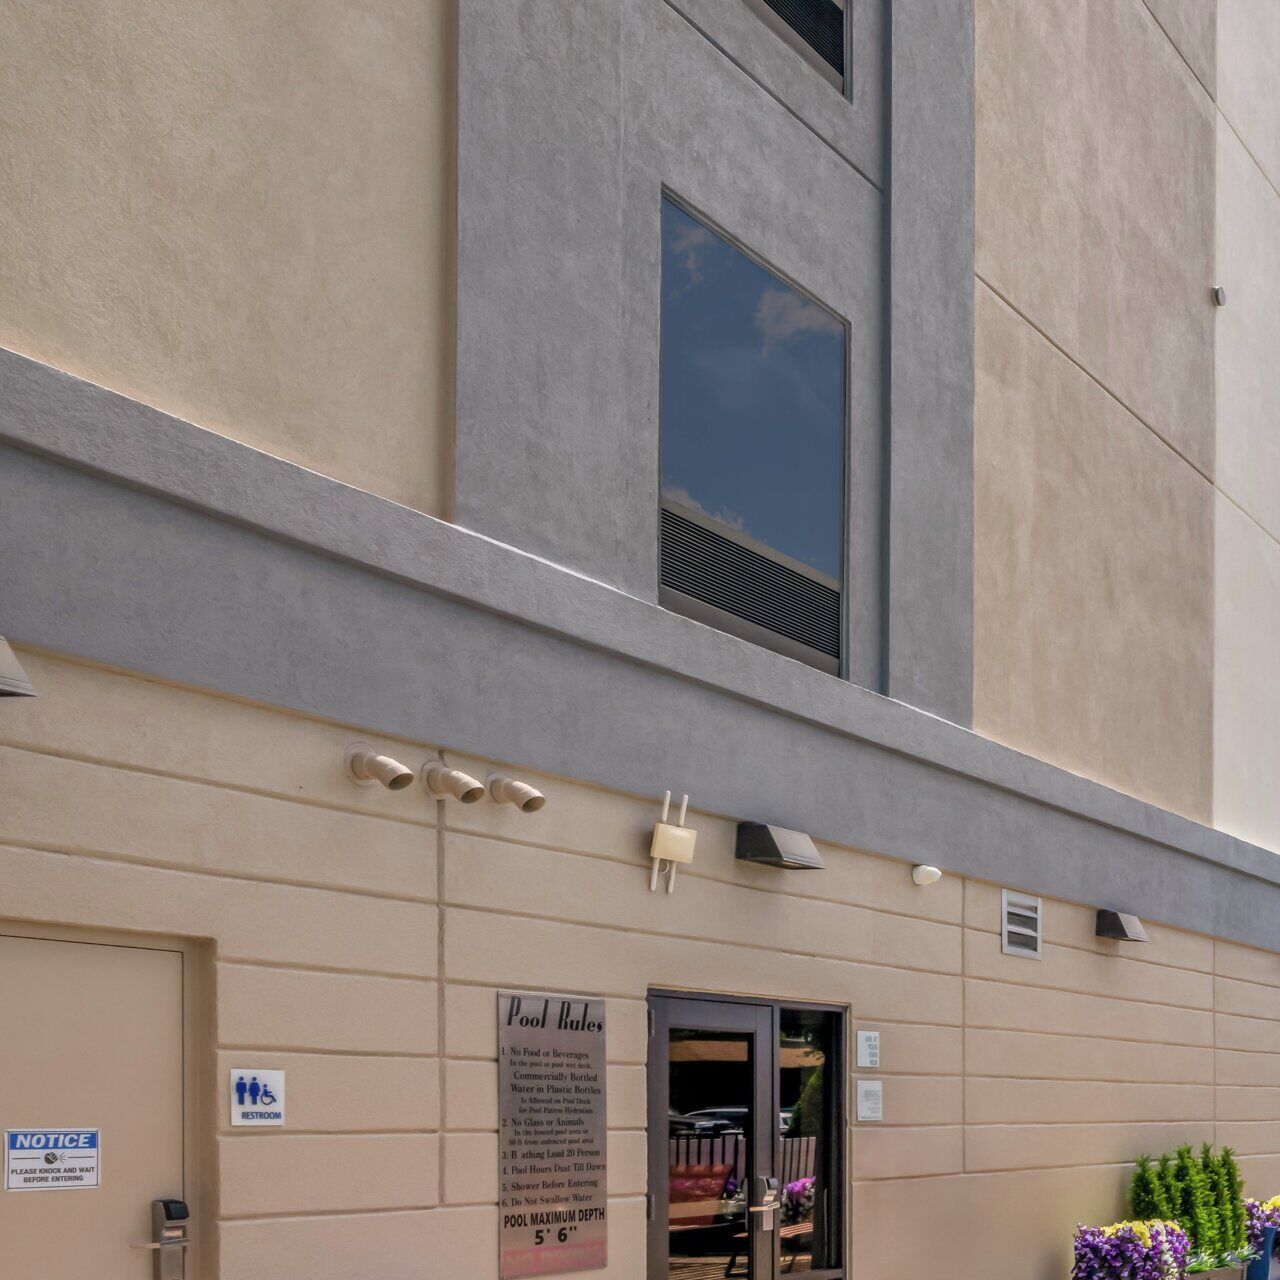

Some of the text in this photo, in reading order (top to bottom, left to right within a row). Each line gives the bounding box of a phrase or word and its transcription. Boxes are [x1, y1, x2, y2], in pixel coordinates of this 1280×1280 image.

[507, 995, 604, 1033] Pool Rules
[502, 1047, 508, 1056] 1.
[510, 1047, 521, 1056] No
[523, 1048, 540, 1057] Food
[552, 1049, 589, 1060] Beverages
[514, 1071, 598, 1082] Commercially Bottled
[510, 1083, 601, 1094] Water in Plastic Bottles
[241, 1111, 282, 1120] RESTROOM
[502, 1118, 509, 1127] 2.
[511, 1118, 522, 1127] No
[524, 1118, 544, 1126] Glass
[556, 1117, 585, 1126] Animals
[15, 1133, 92, 1149] NOTICE
[502, 1151, 509, 1160] 3.
[547, 1149, 565, 1158] Load
[566, 1149, 575, 1157] 20
[577, 1148, 600, 1157] Person
[511, 1165, 527, 1175] Pool
[529, 1164, 552, 1174] Hours
[573, 1163, 584, 1171] Till
[586, 1162, 606, 1171] Dawn
[502, 1179, 598, 1192] 5. Shower Before Entering
[502, 1194, 593, 1207] 6. Do Not Swallow Water
[504, 1208, 605, 1228] POOL MAXIMUM DEPTH
[534, 1228, 550, 1246] 5'
